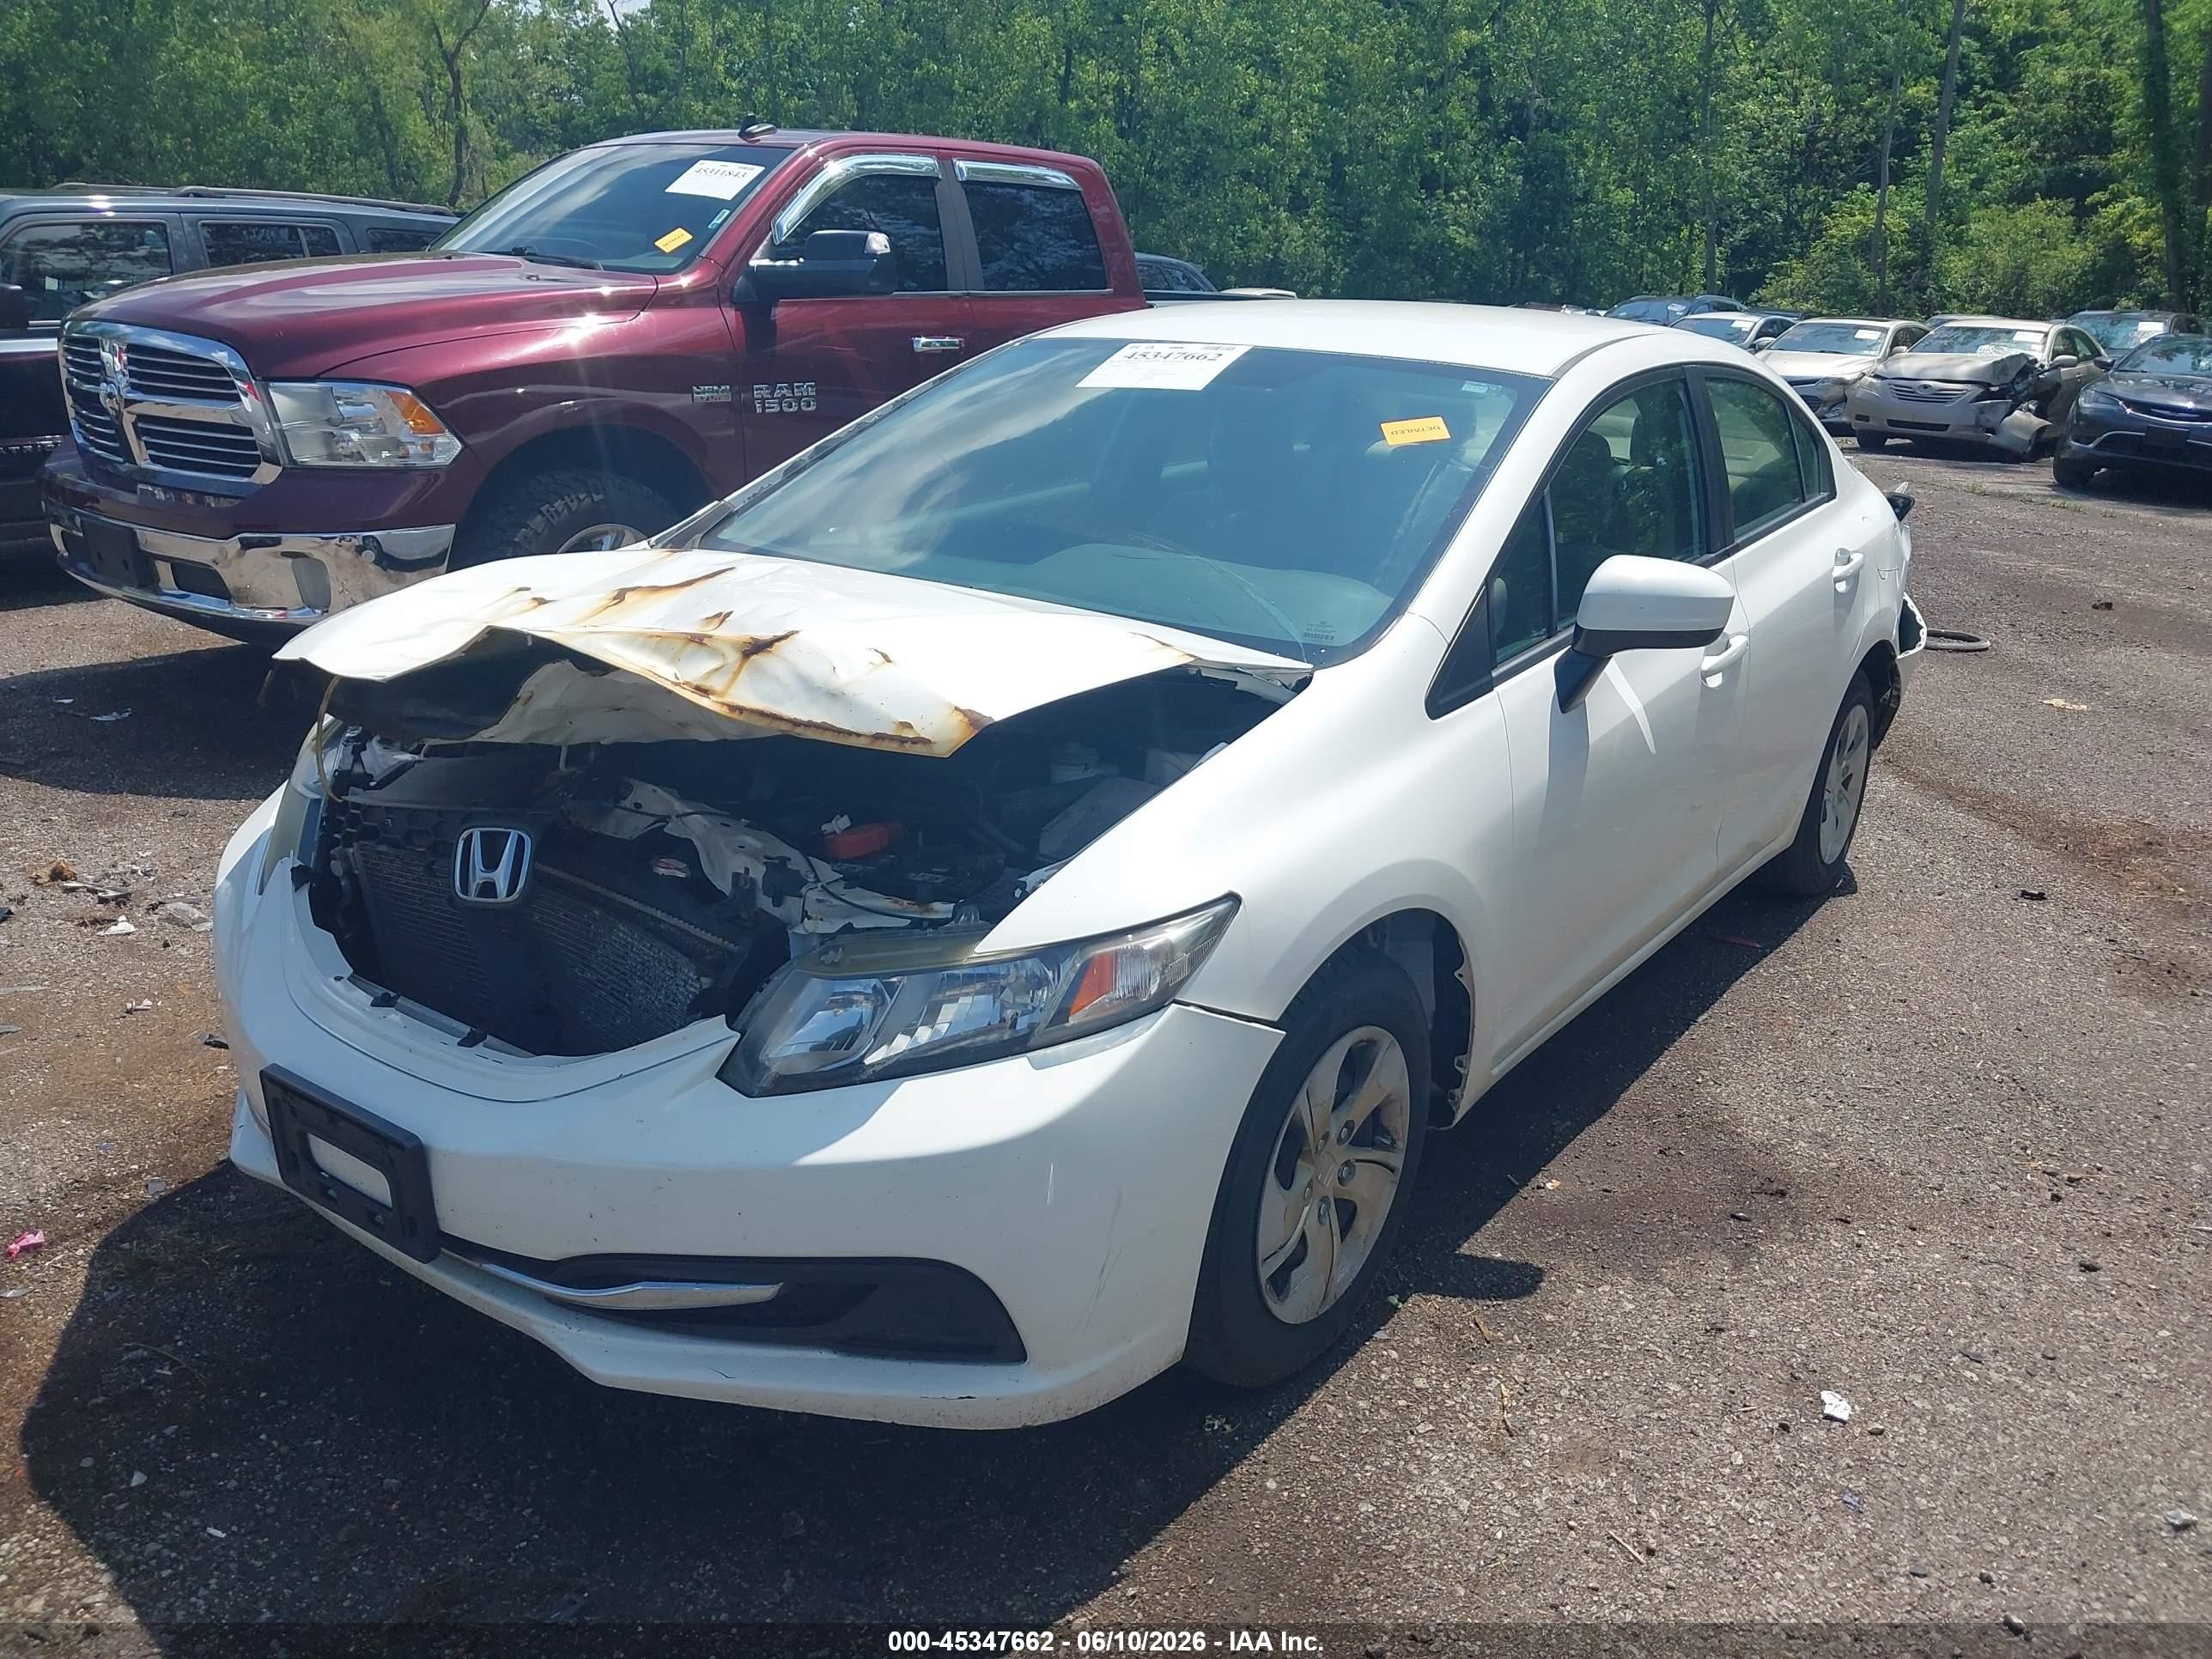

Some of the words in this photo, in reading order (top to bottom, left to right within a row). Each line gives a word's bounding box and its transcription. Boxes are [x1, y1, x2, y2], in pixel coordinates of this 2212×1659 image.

[1123, 351, 1223, 362] 45347662
[753, 382, 816, 398] RAM
[755, 397, 817, 414] 1500
[1390, 425, 1441, 435] DETAILED
